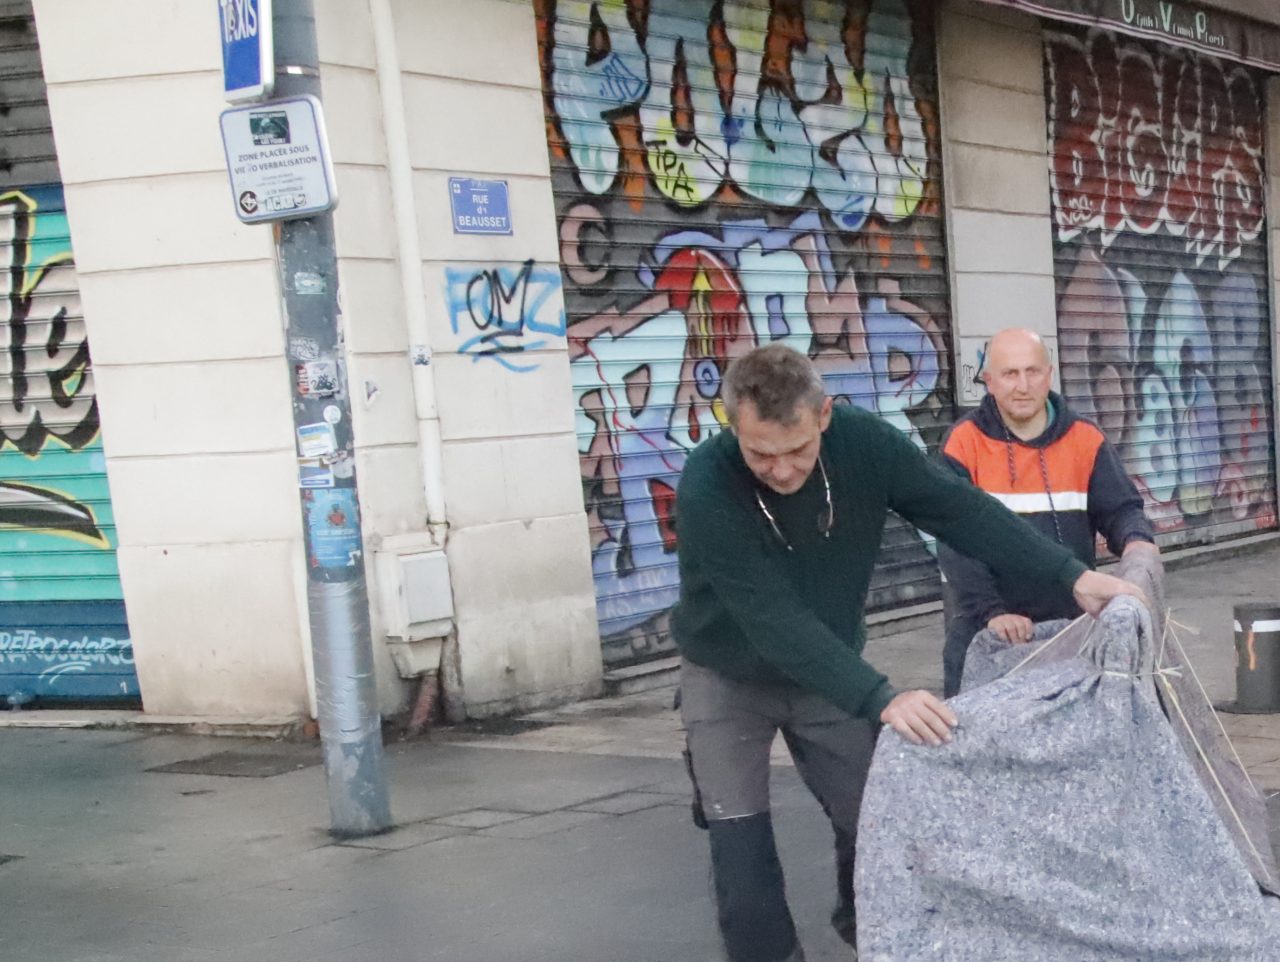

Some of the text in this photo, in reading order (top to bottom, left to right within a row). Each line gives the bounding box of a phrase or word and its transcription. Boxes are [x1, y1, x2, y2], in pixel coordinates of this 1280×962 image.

[238, 153, 259, 162] ZONE
[289, 145, 310, 154] SOUS
[259, 156, 318, 171] VERBALISATION
[472, 194, 489, 204] RUE
[459, 215, 507, 227] BEAUSSET
